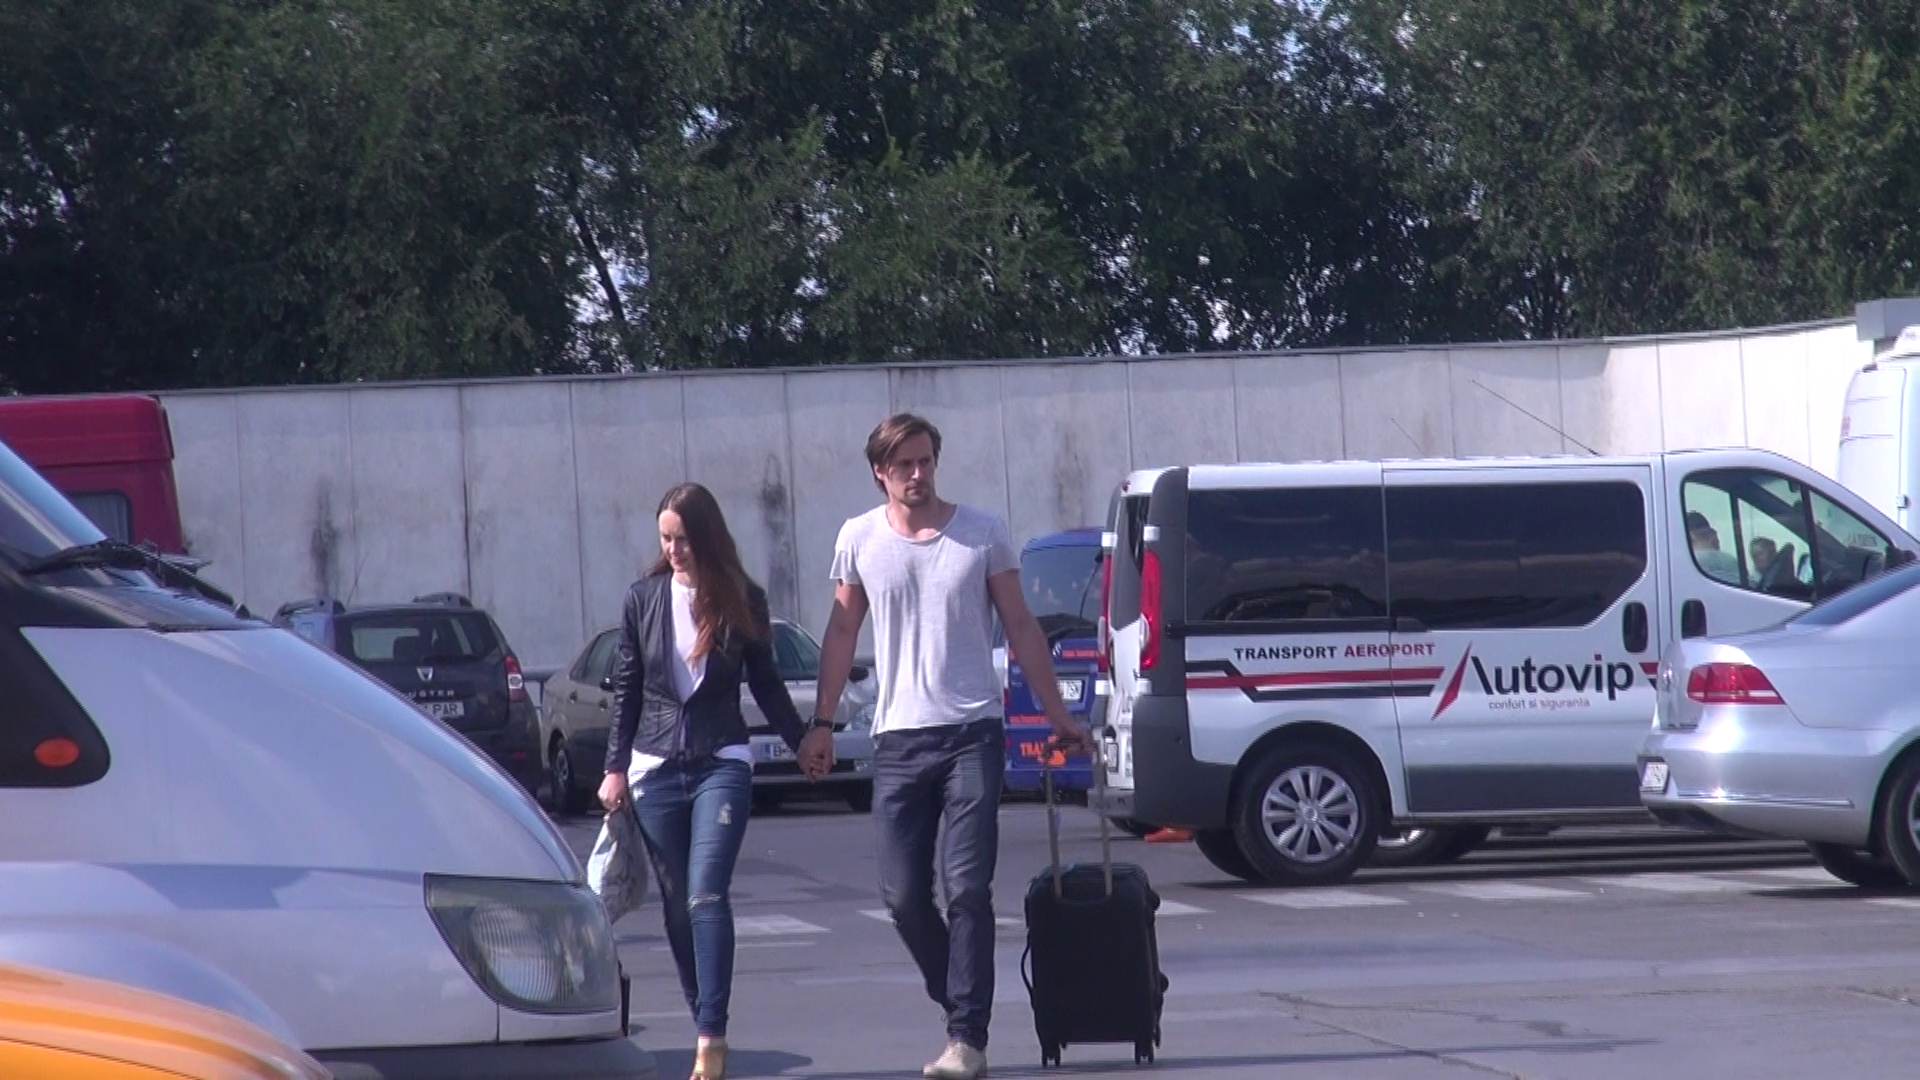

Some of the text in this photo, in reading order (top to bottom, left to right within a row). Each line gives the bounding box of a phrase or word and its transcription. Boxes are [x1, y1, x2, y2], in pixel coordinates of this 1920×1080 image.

[1234, 642, 1436, 660] TRANSPORT AEROPORT
[1488, 697, 1525, 710] confort
[1539, 696, 1591, 711] siguranta
